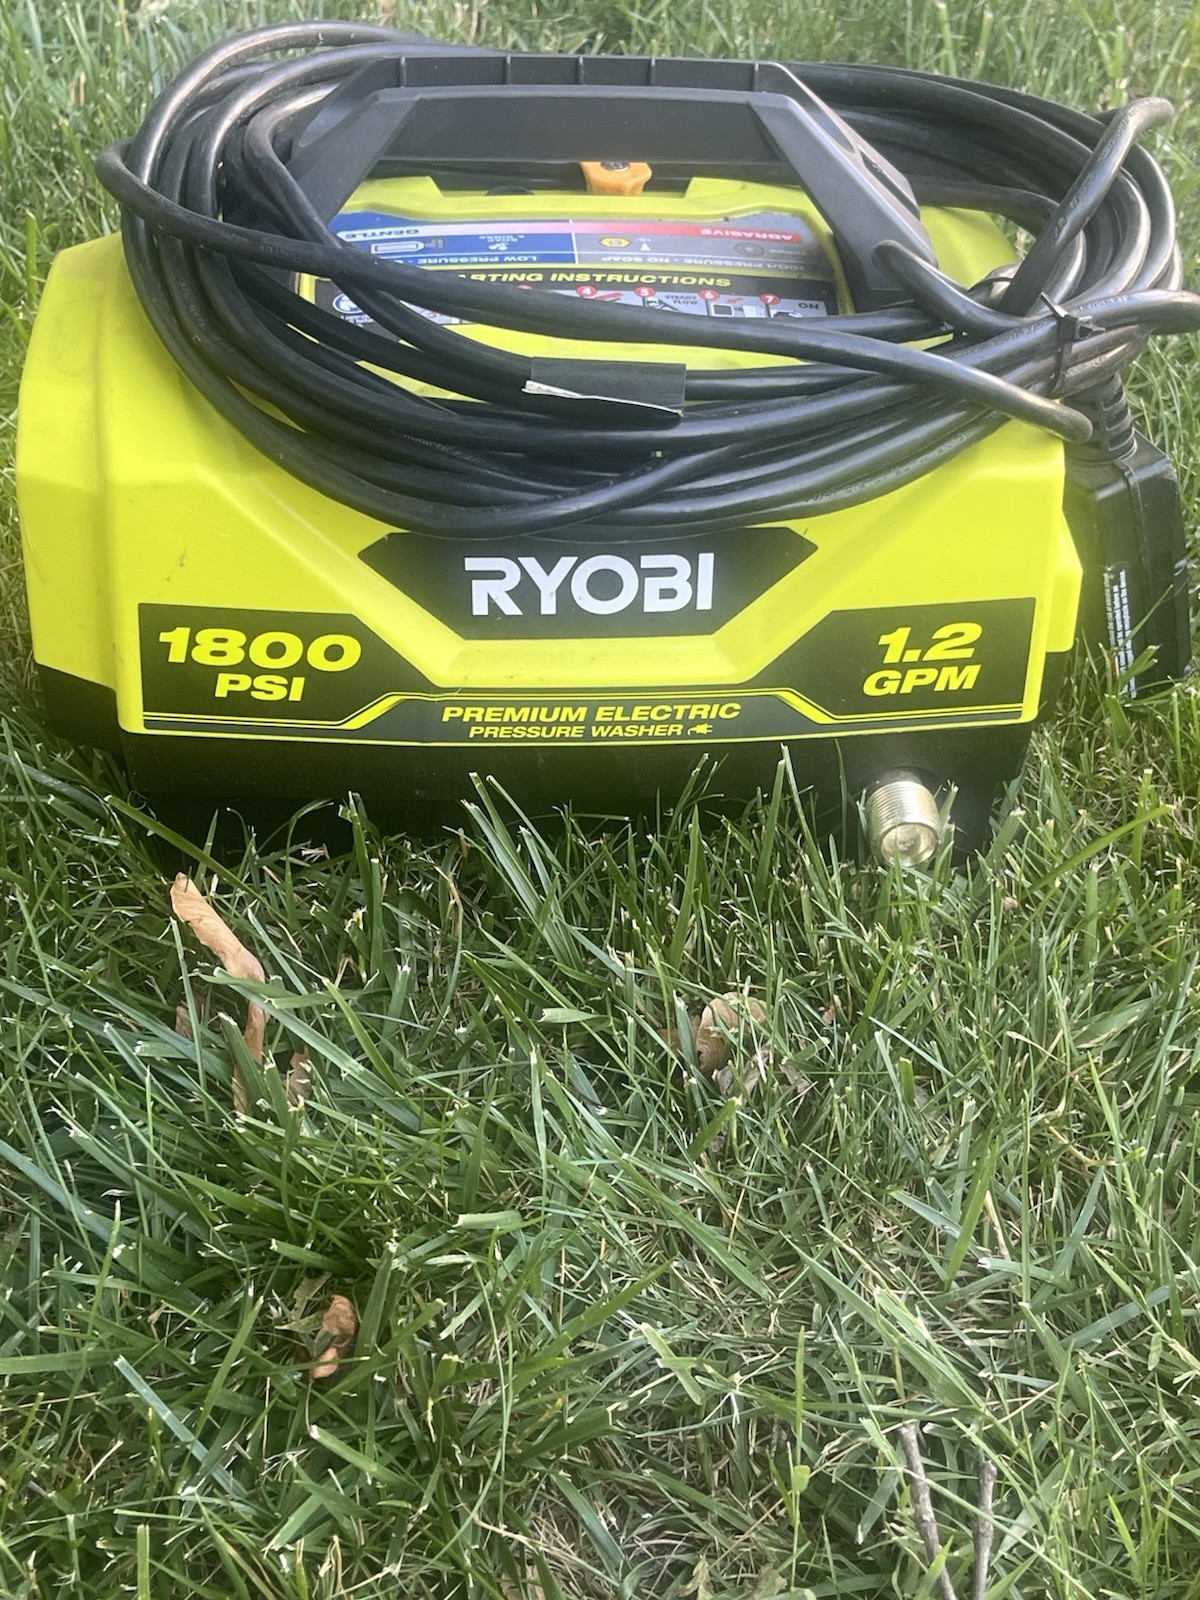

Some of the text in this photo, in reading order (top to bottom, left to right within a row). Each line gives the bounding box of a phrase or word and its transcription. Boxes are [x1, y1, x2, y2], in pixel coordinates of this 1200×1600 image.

[345, 229, 420, 240] GENTLE
[701, 228, 794, 241] ABRASIVE
[418, 256, 500, 265] PRESSURE
[683, 258, 763, 269] PRESSURE
[550, 273, 731, 287] INSTRUCTIONS
[582, 287, 591, 296] 4
[641, 288, 649, 297] 5
[705, 291, 714, 300] 6
[766, 295, 774, 304] 7
[798, 302, 820, 310] ON
[464, 552, 715, 616] RYOBI
[158, 626, 361, 672] 1800
[878, 622, 982, 664] 1.2
[863, 664, 982, 697] GPM
[214, 673, 305, 702] PSI
[441, 702, 742, 723] PREMIUM ELECTRIC
[469, 724, 683, 739] PRESSURE WASHER
